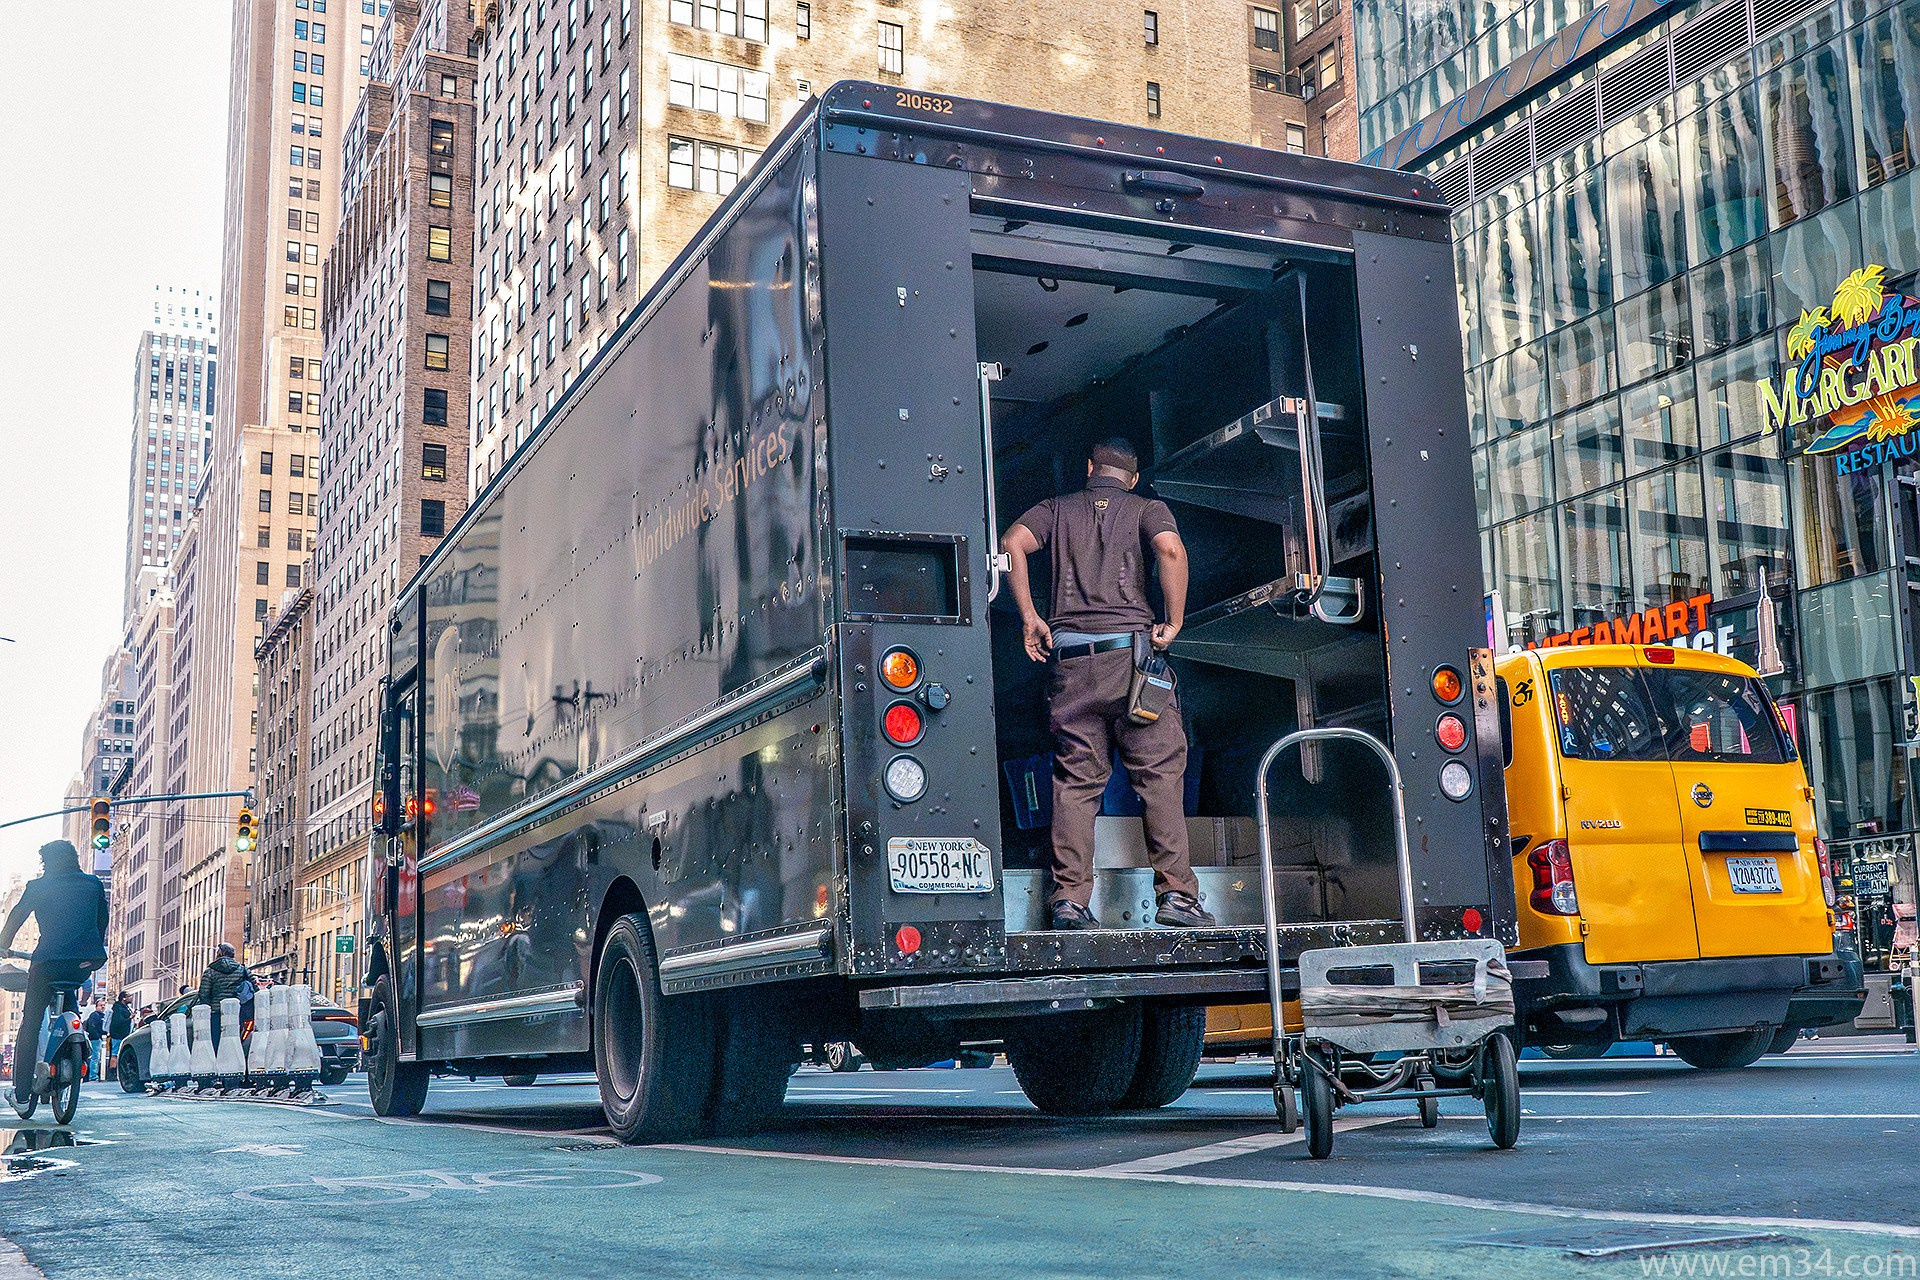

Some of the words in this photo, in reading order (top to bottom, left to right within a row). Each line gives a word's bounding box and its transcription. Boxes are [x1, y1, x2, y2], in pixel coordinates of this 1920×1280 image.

[896, 92, 954, 115] 210532
[1796, 321, 1875, 399] Jimmy
[1757, 337, 1920, 436] MARGARI
[633, 484, 710, 574] Worldwide
[714, 421, 787, 510] Services
[1527, 593, 1712, 651] GAMART
[1581, 819, 1622, 829] NV200
[915, 842, 937, 851] NEW
[940, 842, 965, 851] YORK
[1732, 866, 1777, 885] Y204372C
[1853, 862, 1887, 874] CURRENCY
[1855, 871, 1887, 882] EXCHANGE
[1872, 880, 1888, 891] ATM
